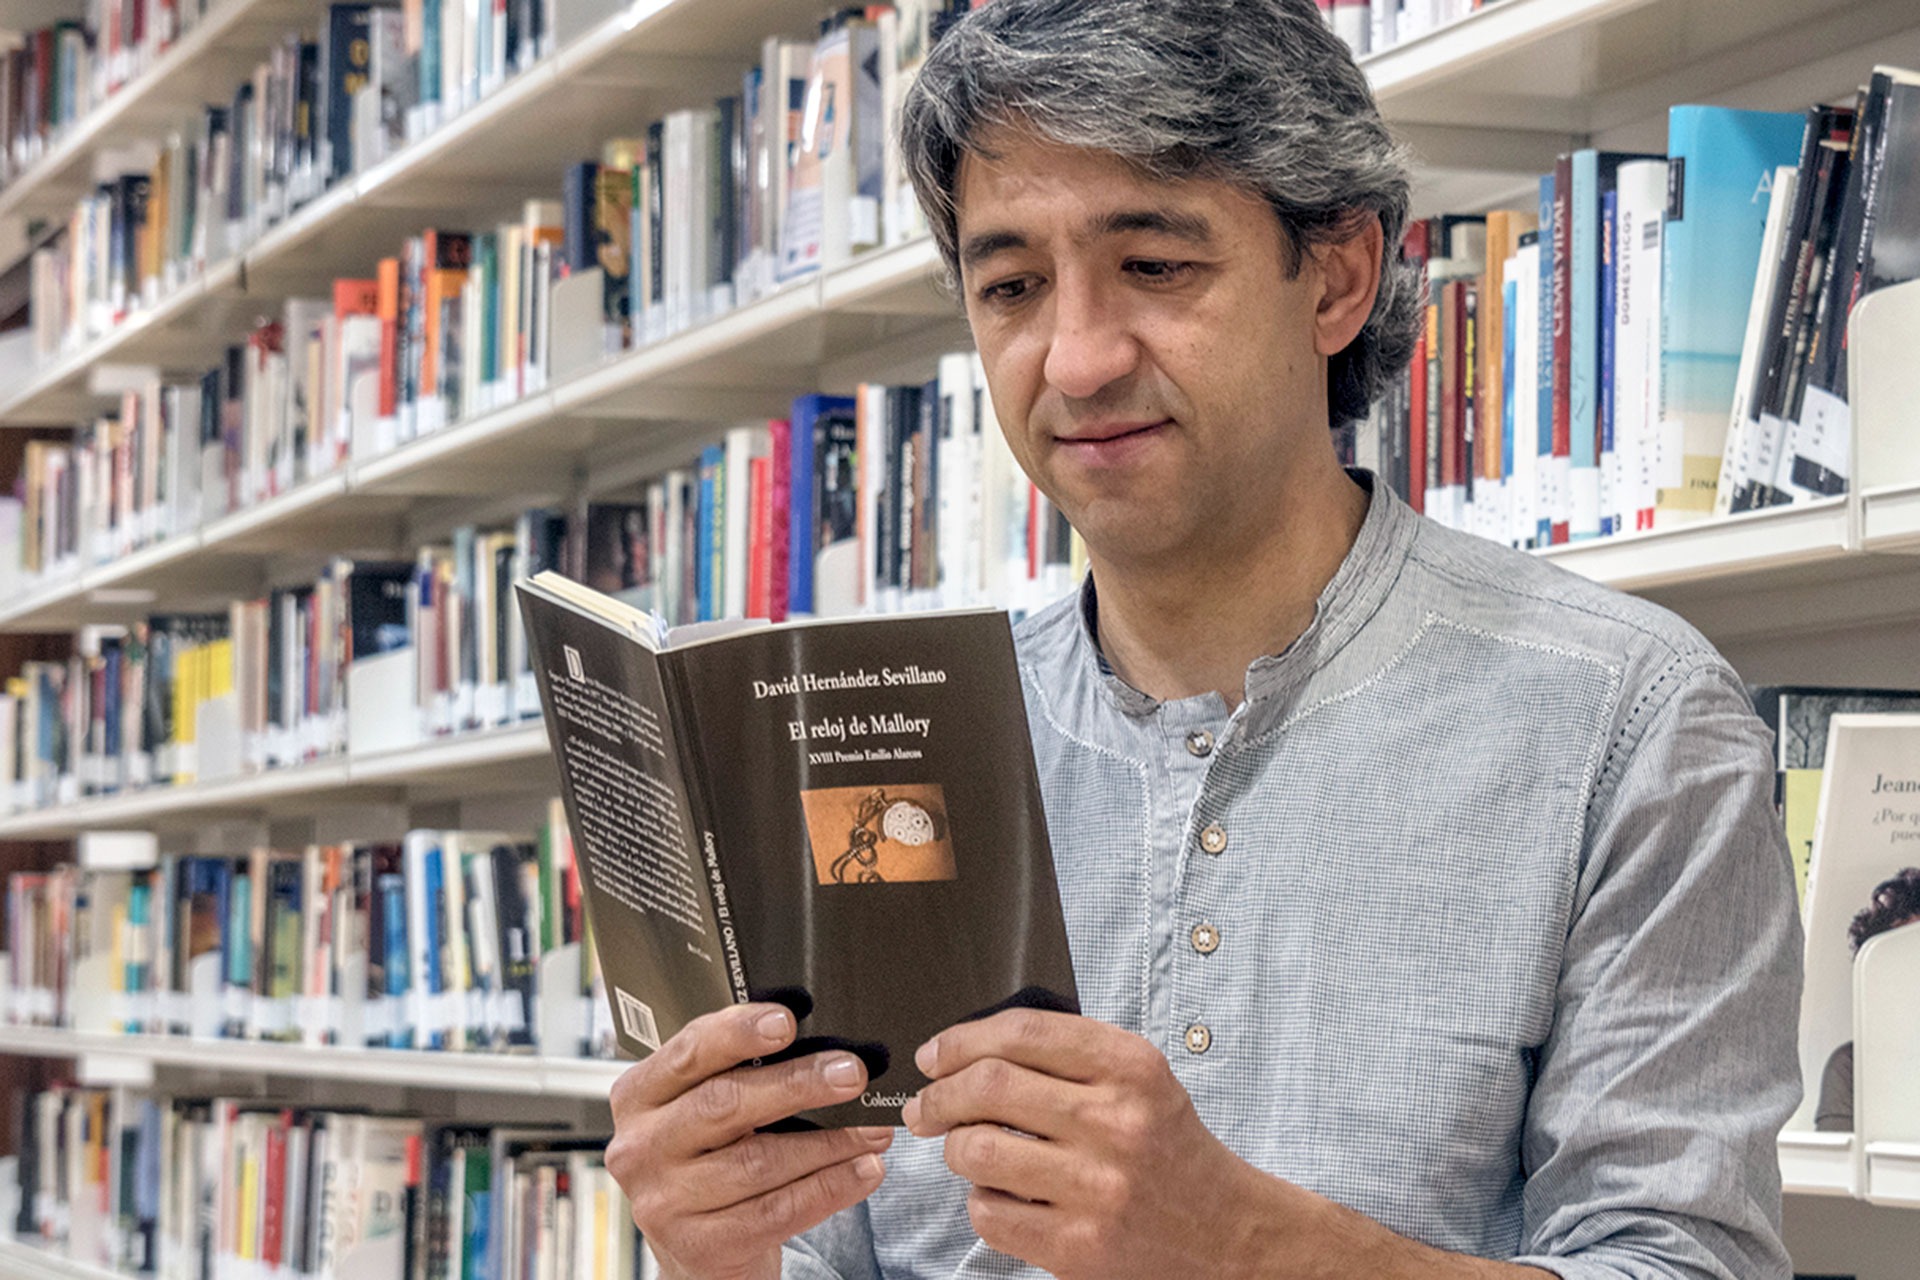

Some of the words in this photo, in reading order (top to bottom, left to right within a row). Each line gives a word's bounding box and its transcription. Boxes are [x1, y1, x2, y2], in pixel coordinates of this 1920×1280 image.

[753, 674, 800, 699] David
[802, 668, 881, 692] Hernández
[881, 665, 947, 686] Sevillano
[788, 720, 807, 741] El
[810, 715, 846, 742] reloj
[849, 715, 868, 736] de
[869, 711, 931, 738] Mallory
[808, 751, 834, 765] XVIII
[835, 750, 864, 763] Premio
[865, 748, 892, 761] Emilio
[893, 747, 923, 760] Alarcos
[1872, 773, 1920, 794] Jean
[711, 868, 722, 882] de
[713, 883, 728, 906] reloj
[717, 906, 730, 919] El
[722, 928, 747, 992] SEVILLANO
